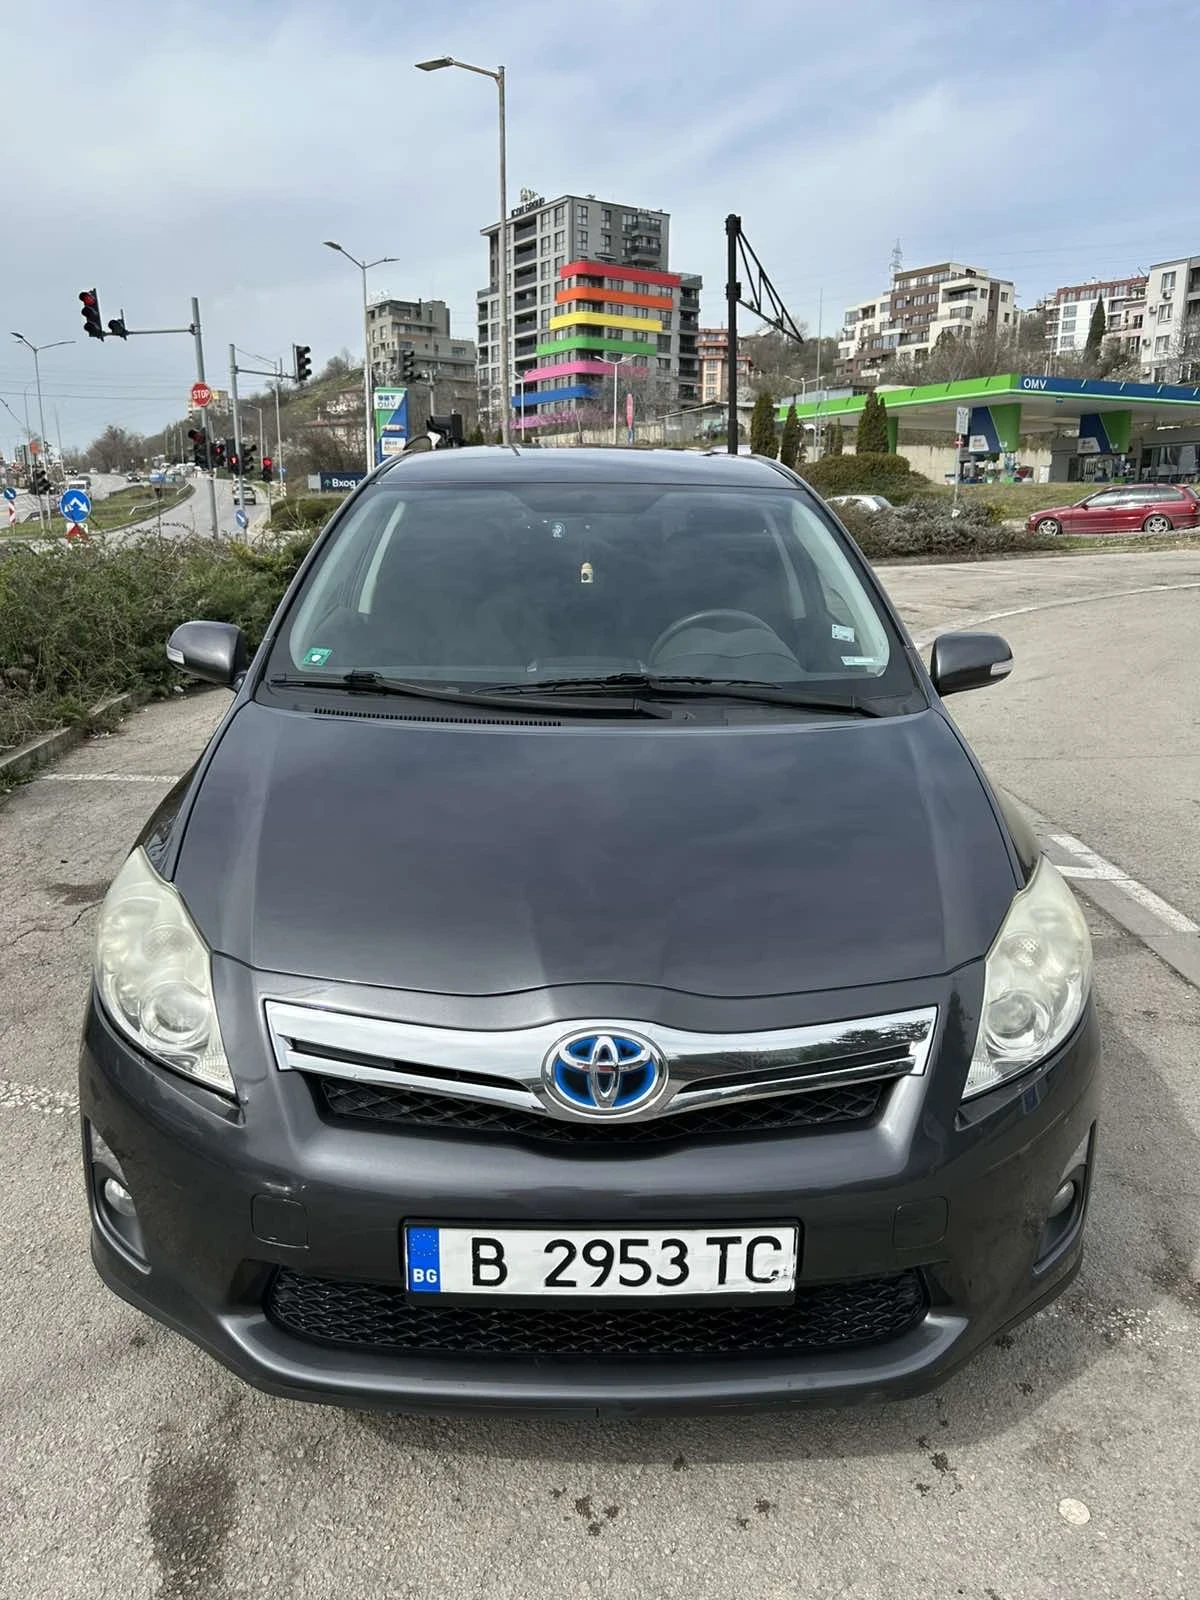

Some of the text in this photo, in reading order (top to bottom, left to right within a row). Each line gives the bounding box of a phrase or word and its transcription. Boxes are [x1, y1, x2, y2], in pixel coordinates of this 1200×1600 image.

[1023, 377, 1047, 390] OMV
[193, 390, 209, 399] STOP
[471, 1235, 782, 1288] B 2953 TC
[412, 1268, 438, 1283] BG
